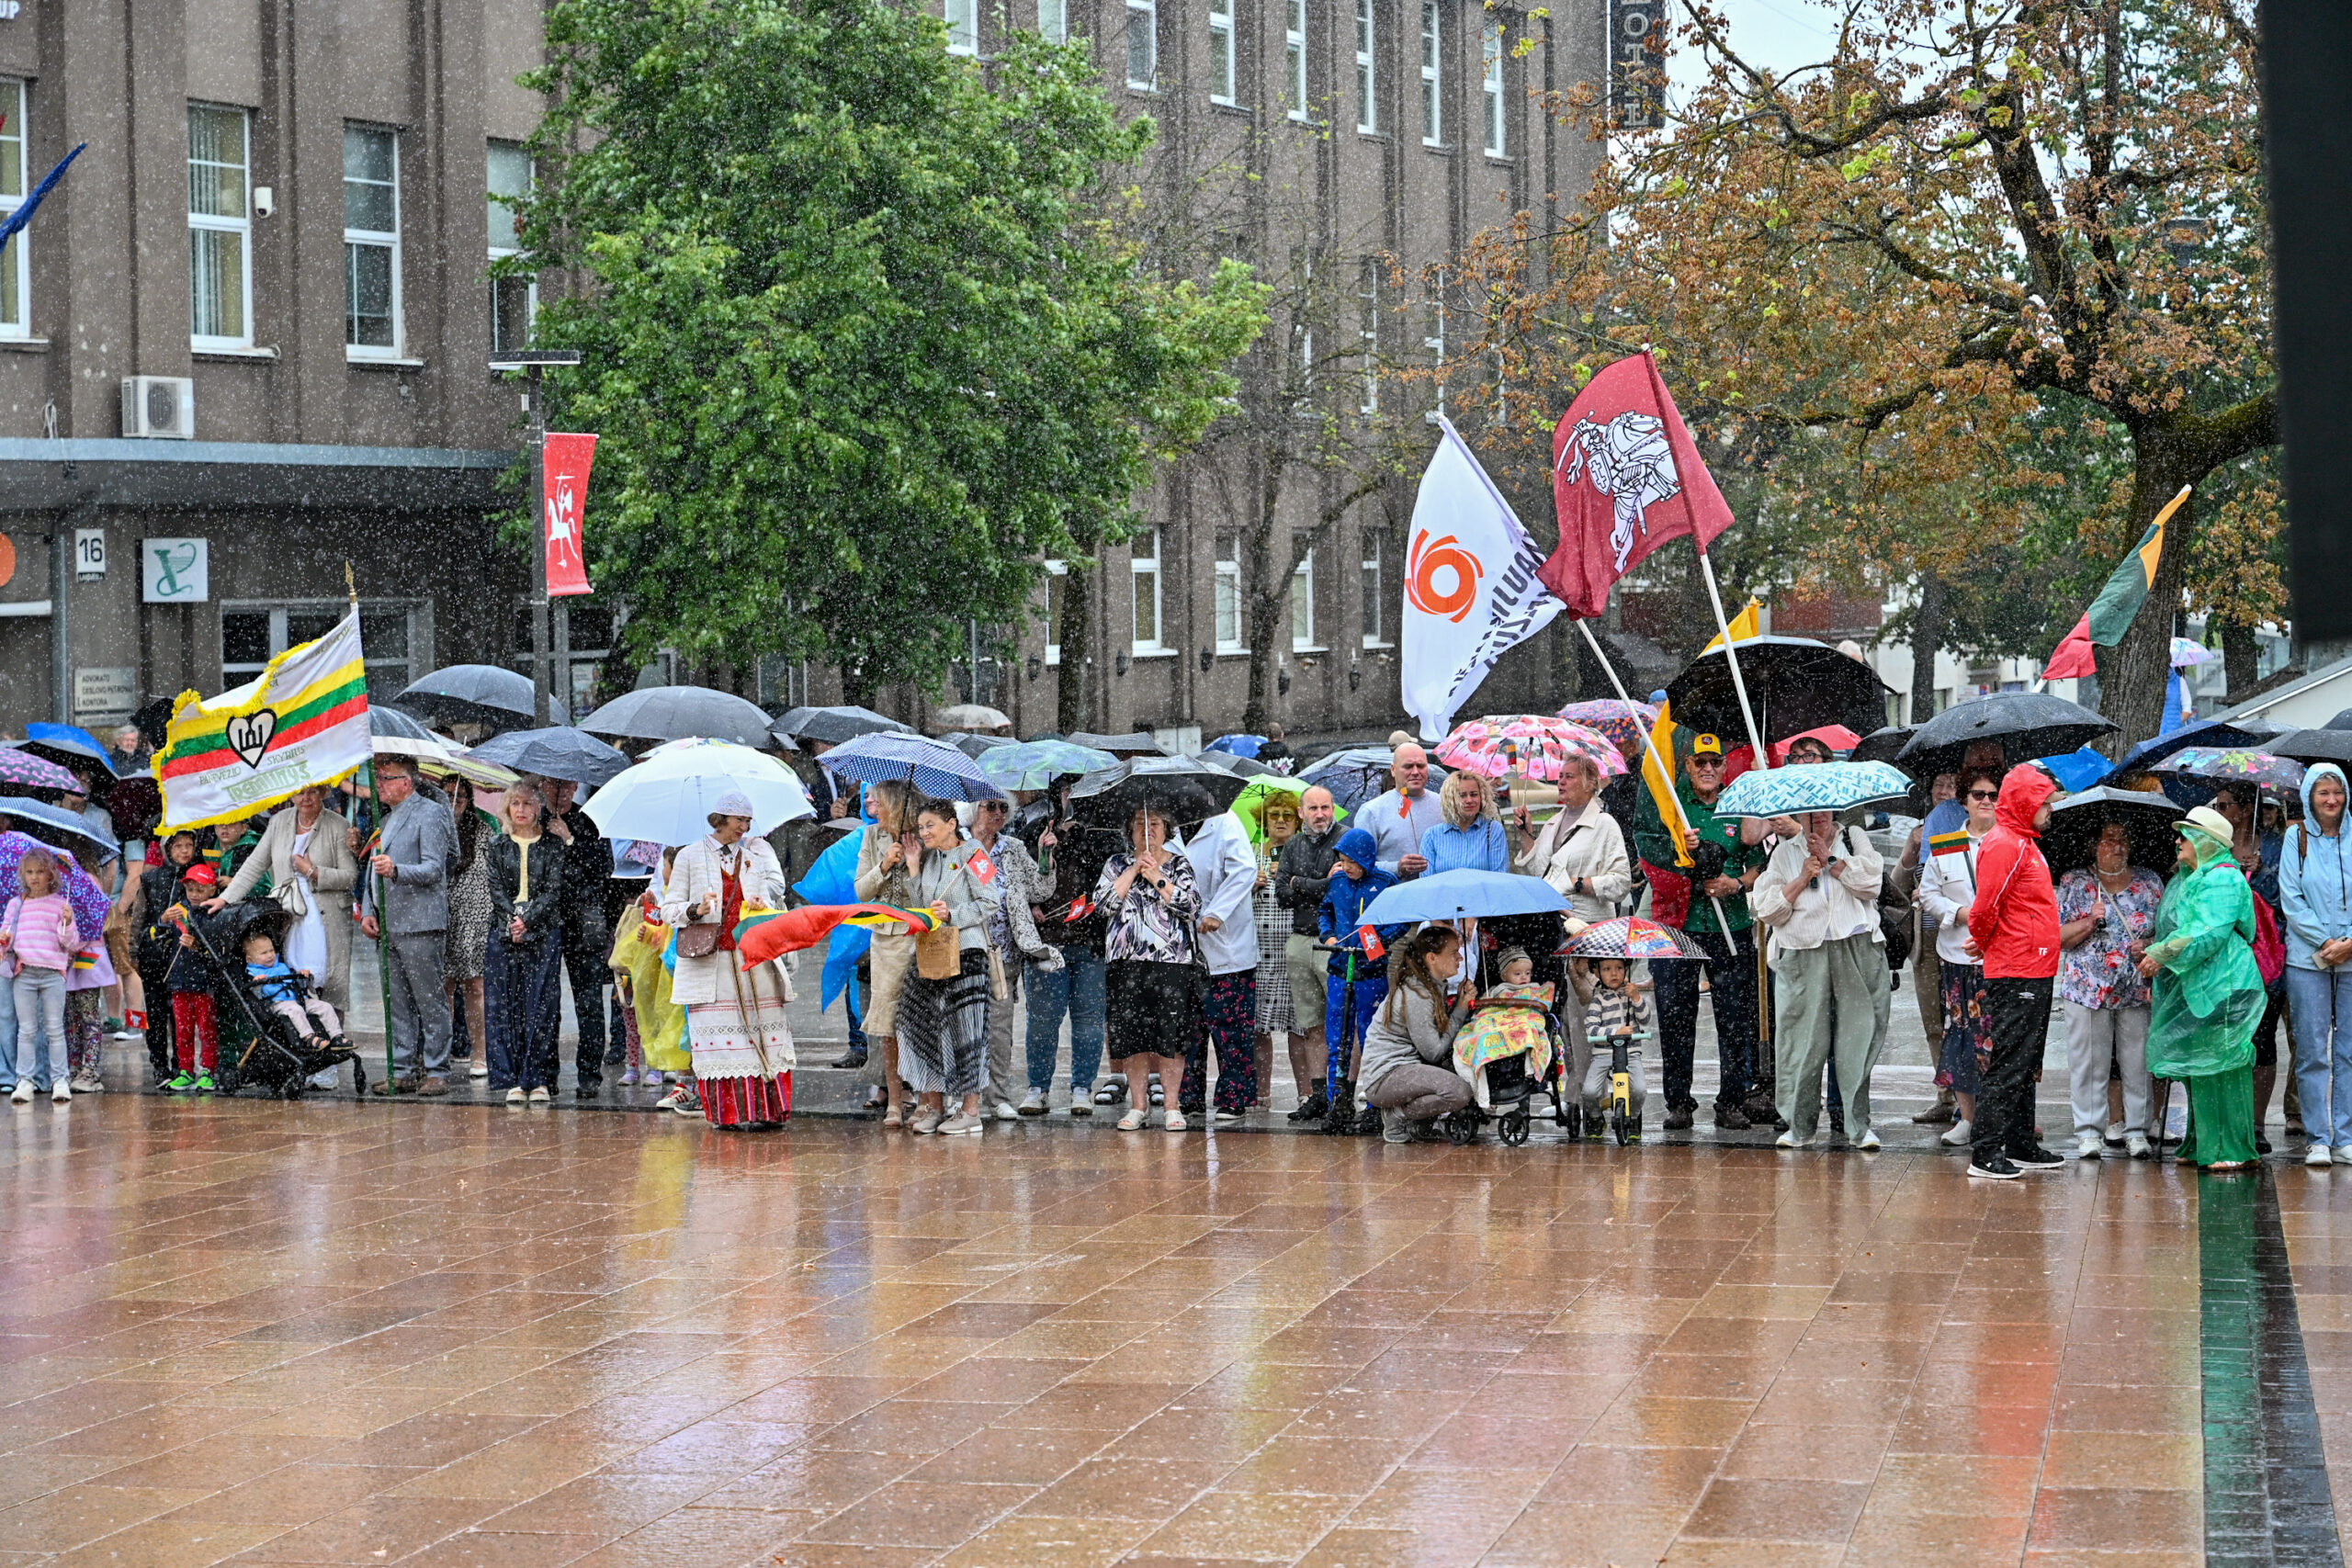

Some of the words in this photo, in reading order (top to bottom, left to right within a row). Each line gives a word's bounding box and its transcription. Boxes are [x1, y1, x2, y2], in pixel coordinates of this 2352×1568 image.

[1621, 0, 1648, 127] OTEL
[79, 537, 103, 562] 16
[267, 745, 307, 766] SKYRIUS
[2038, 947, 2048, 956] TF
